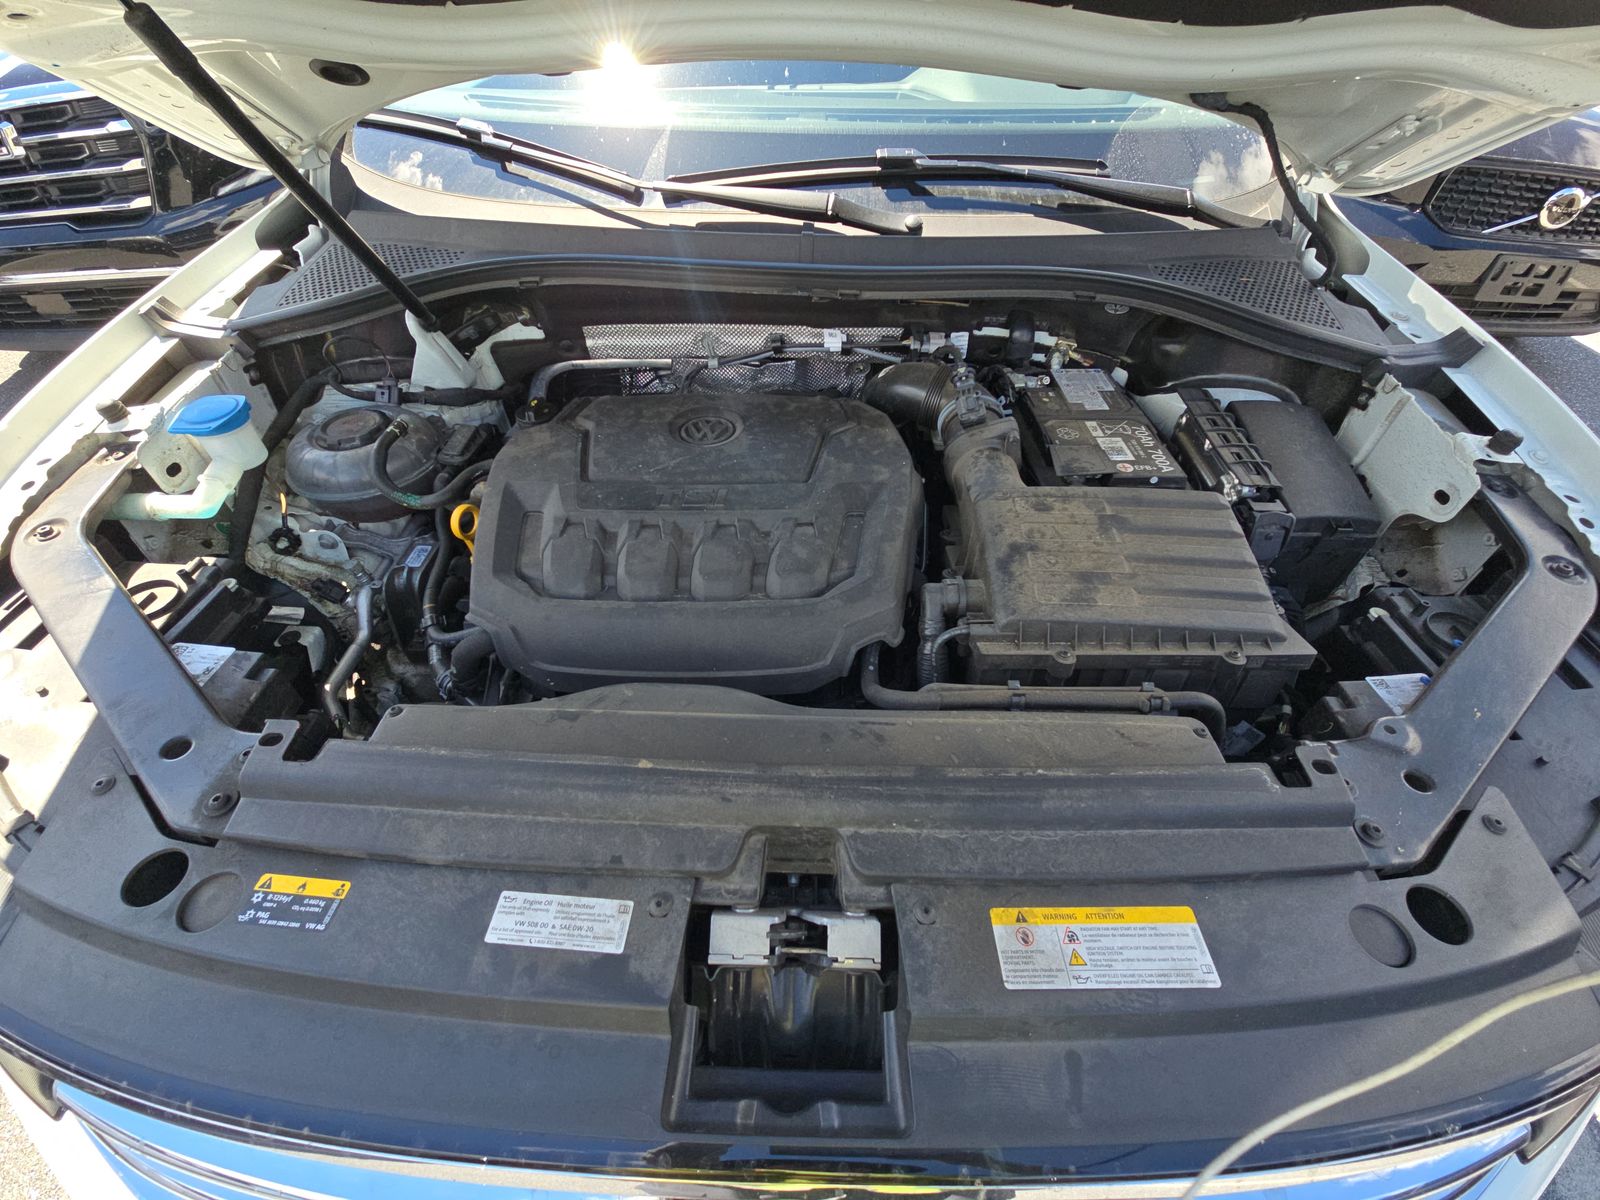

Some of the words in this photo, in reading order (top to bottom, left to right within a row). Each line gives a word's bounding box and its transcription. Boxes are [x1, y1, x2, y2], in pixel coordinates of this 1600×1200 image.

[1131, 425, 1155, 447] 70Ah
[1147, 449, 1175, 473] 700A
[266, 893, 294, 904] R-1234yf
[523, 898, 543, 907] Engine
[256, 911, 271, 919] PAG
